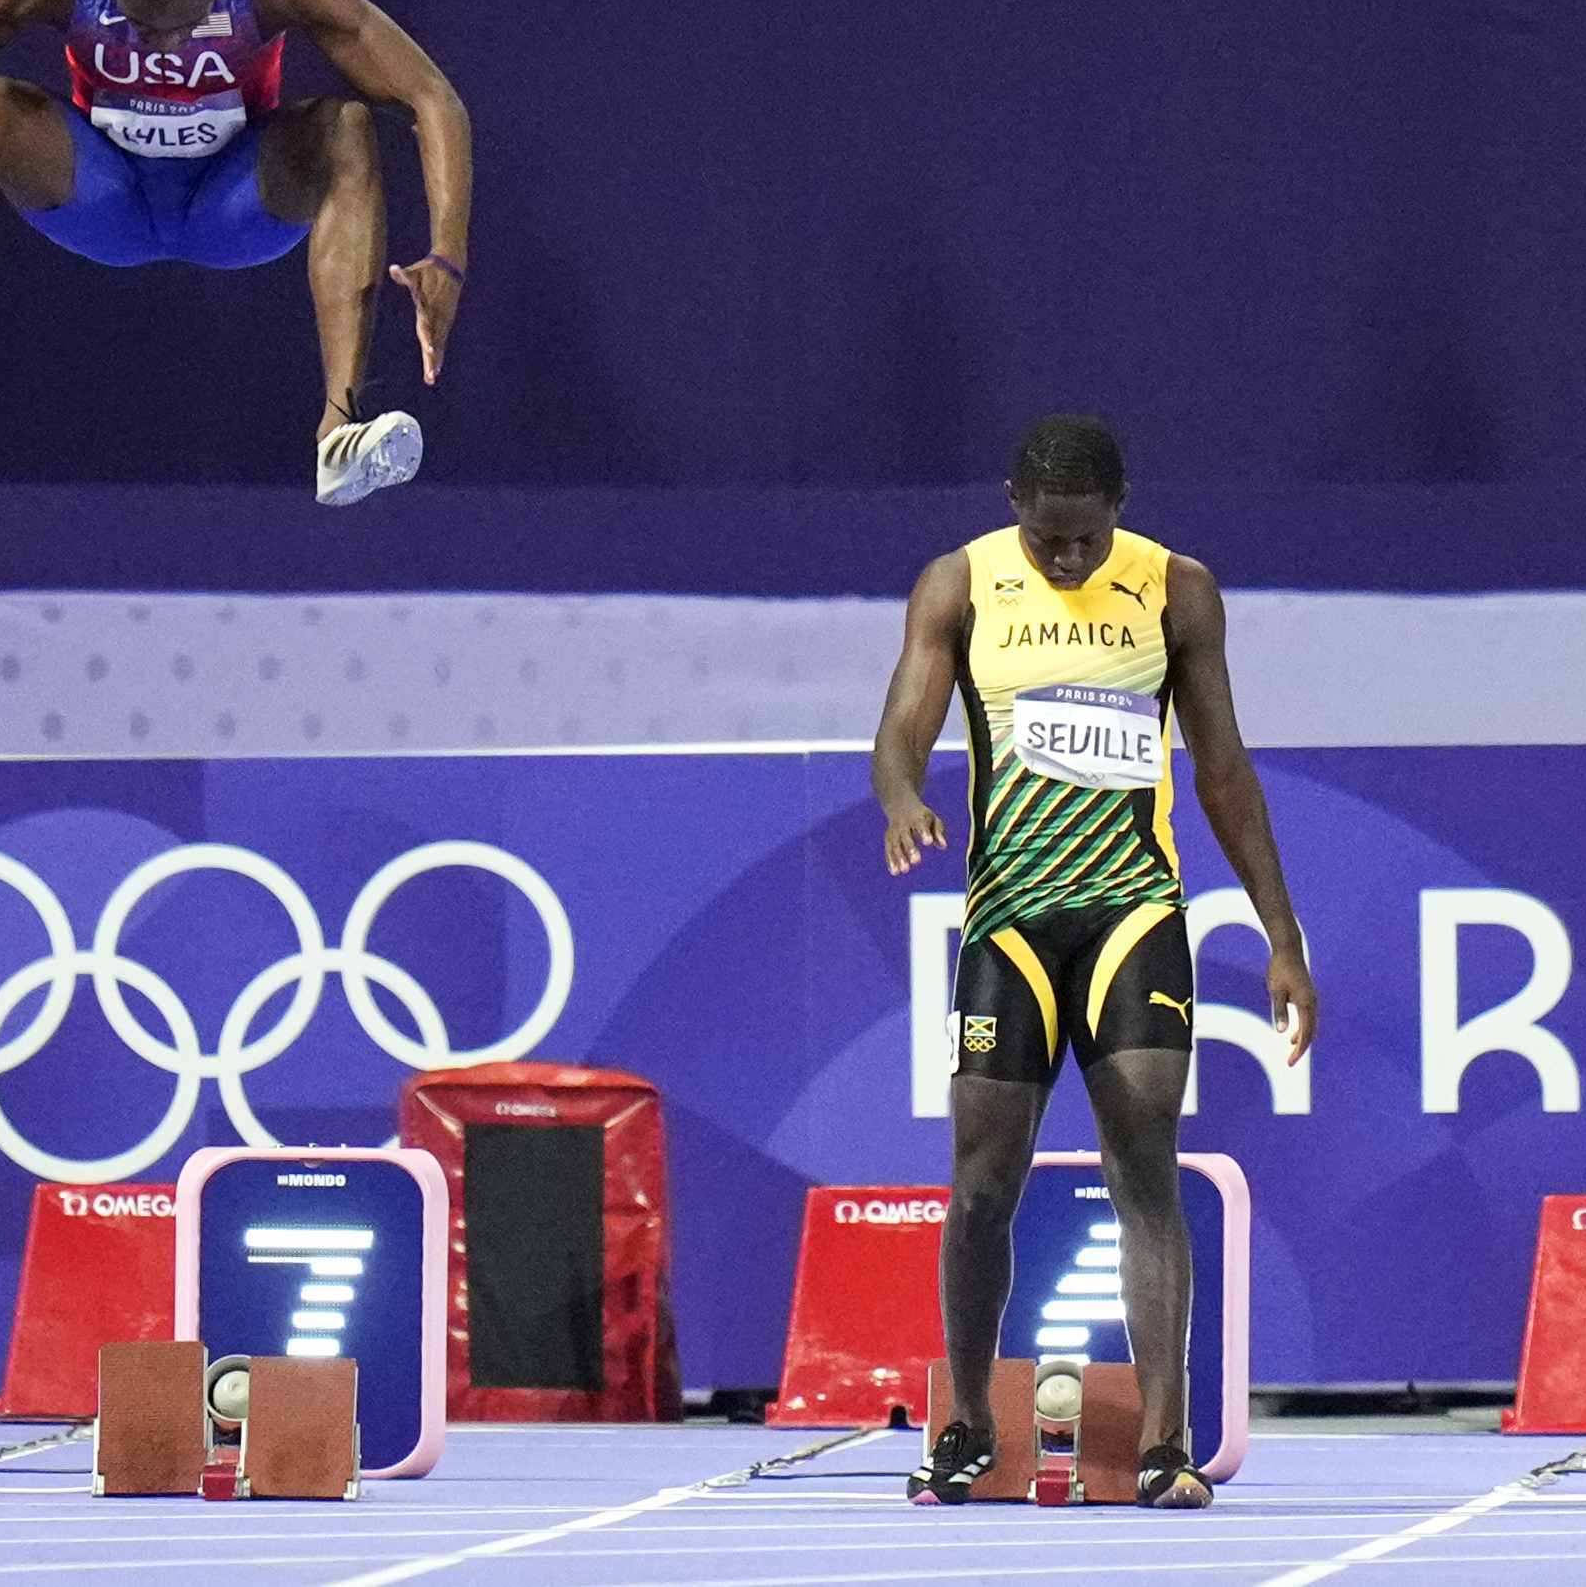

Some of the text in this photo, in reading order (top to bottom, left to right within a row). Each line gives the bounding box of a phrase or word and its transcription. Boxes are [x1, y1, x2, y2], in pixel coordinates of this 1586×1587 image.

[94, 43, 235, 88] USA
[123, 122, 218, 146] LYLES
[999, 622, 1136, 649] JAMAICA
[1056, 688, 1133, 707] PARIS 2024
[1027, 721, 1155, 765] SEVILLE
[289, 1174, 347, 1187] MONDO
[863, 1199, 949, 1223] OMEG
[244, 1226, 374, 1357] 7
